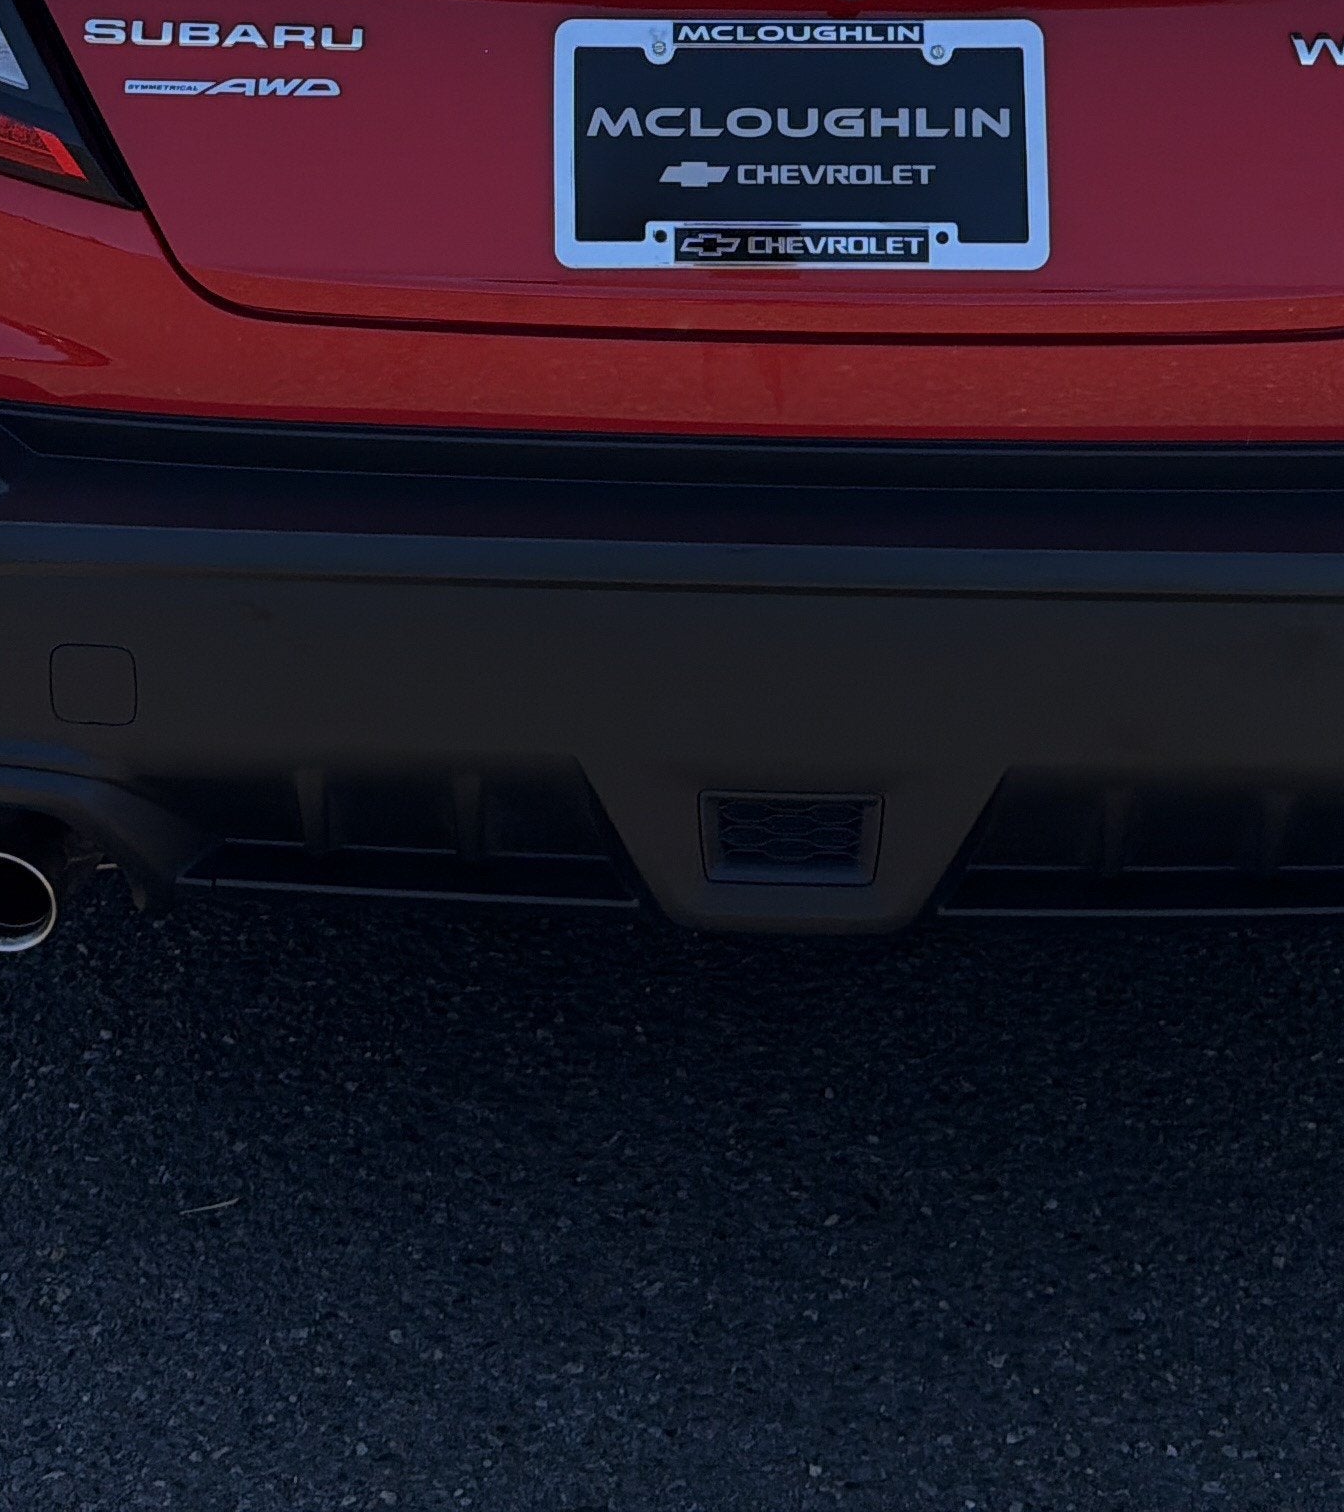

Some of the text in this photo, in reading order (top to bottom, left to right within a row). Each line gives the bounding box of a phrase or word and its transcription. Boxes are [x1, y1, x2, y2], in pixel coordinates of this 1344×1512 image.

[83, 18, 364, 50] SUBARU
[677, 25, 922, 42] MCLOUGHLIN
[127, 78, 342, 97] SYMMETRICAL AWD
[586, 107, 1012, 138] MCLOUGHLIN
[737, 164, 937, 185] CHEVROLET
[747, 236, 925, 255] CHEVROLET
